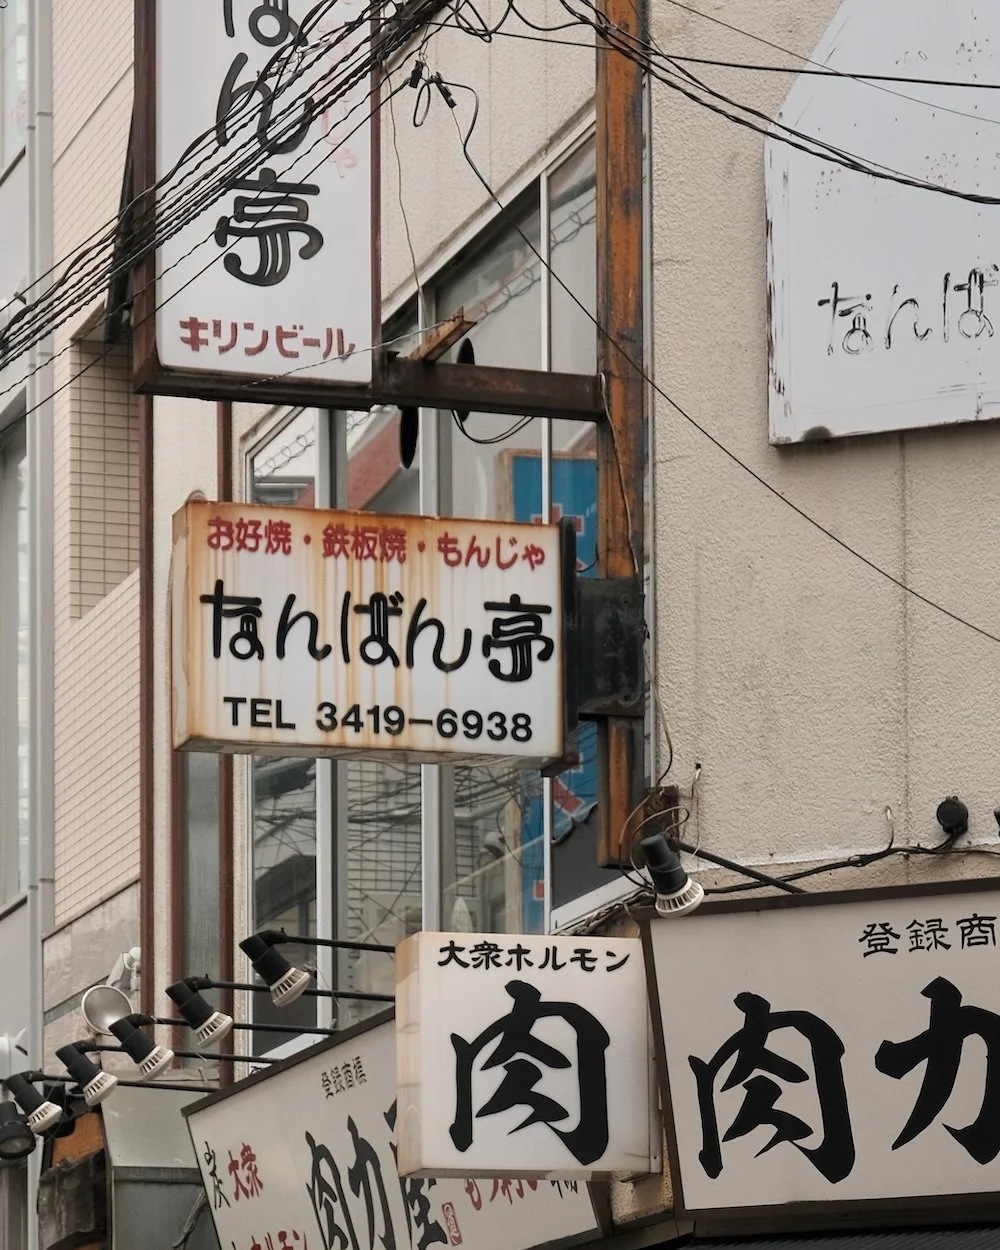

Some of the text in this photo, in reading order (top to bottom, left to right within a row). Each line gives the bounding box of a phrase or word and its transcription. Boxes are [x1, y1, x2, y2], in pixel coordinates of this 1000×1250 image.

[179, 316, 355, 362] キリンビール
[199, 579, 556, 682] なんばん亭
[223, 697, 296, 731] TEL
[436, 939, 631, 973] 大衆ホルモン
[450, 979, 610, 1166] 肉
[228, 1142, 263, 1202] 大衆
